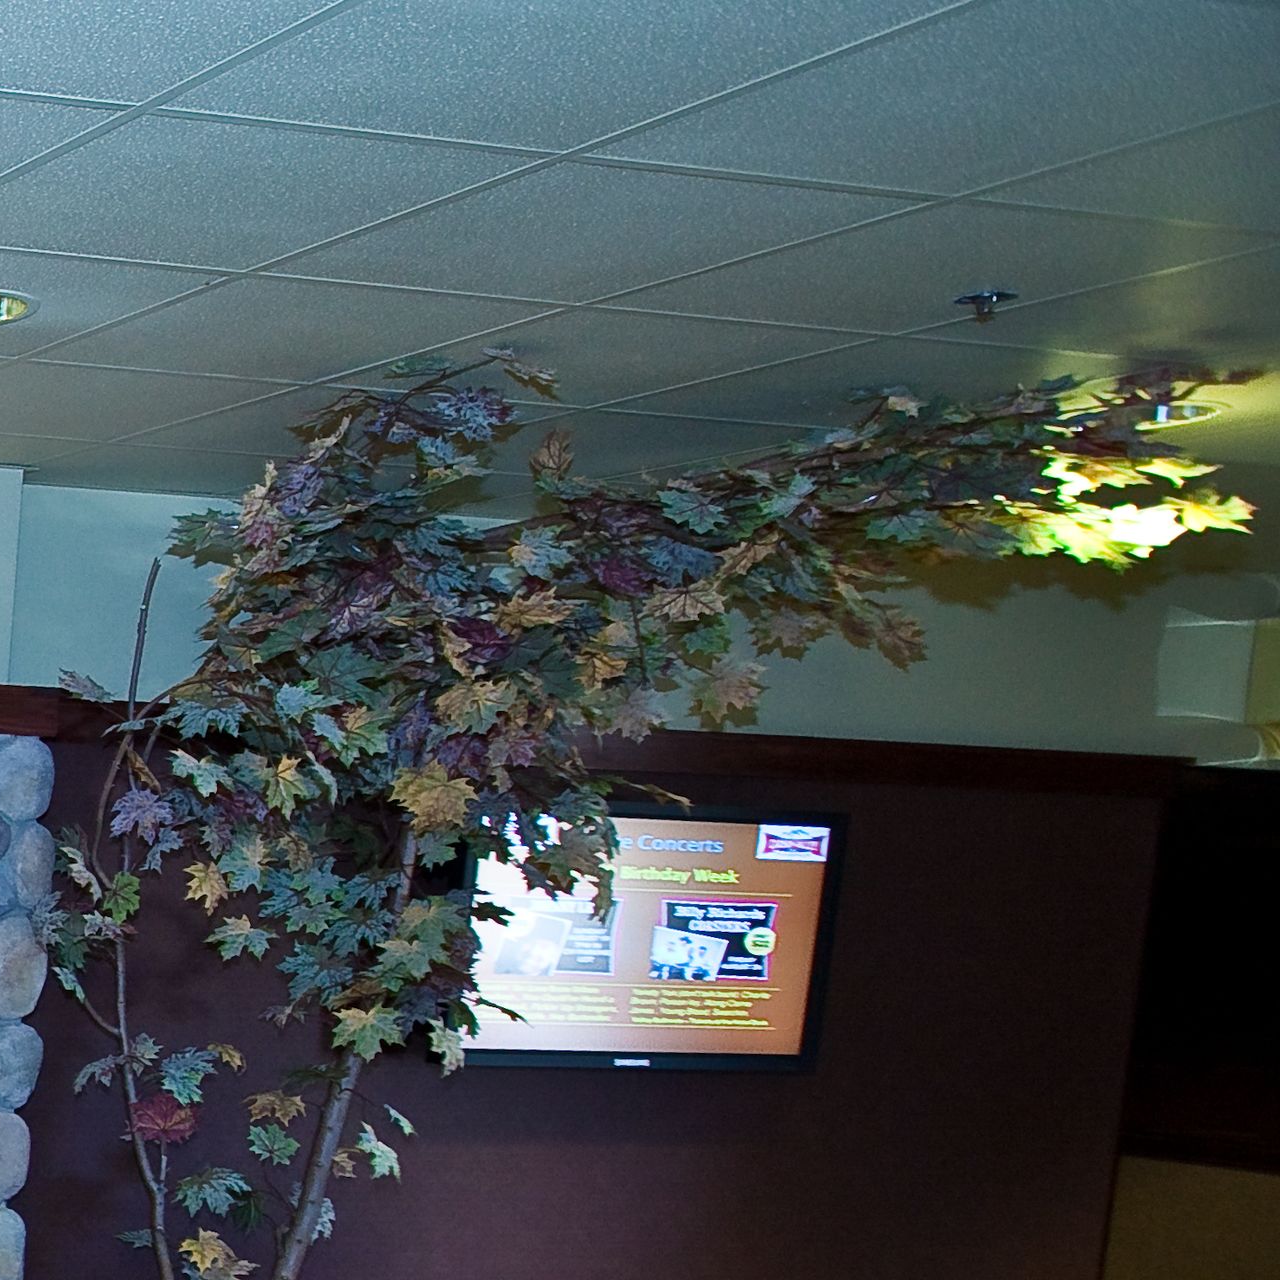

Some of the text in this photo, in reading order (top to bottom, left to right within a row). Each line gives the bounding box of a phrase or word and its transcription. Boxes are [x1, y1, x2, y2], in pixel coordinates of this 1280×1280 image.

[637, 834, 725, 854] Concerts
[619, 865, 740, 885] Birthday Week
